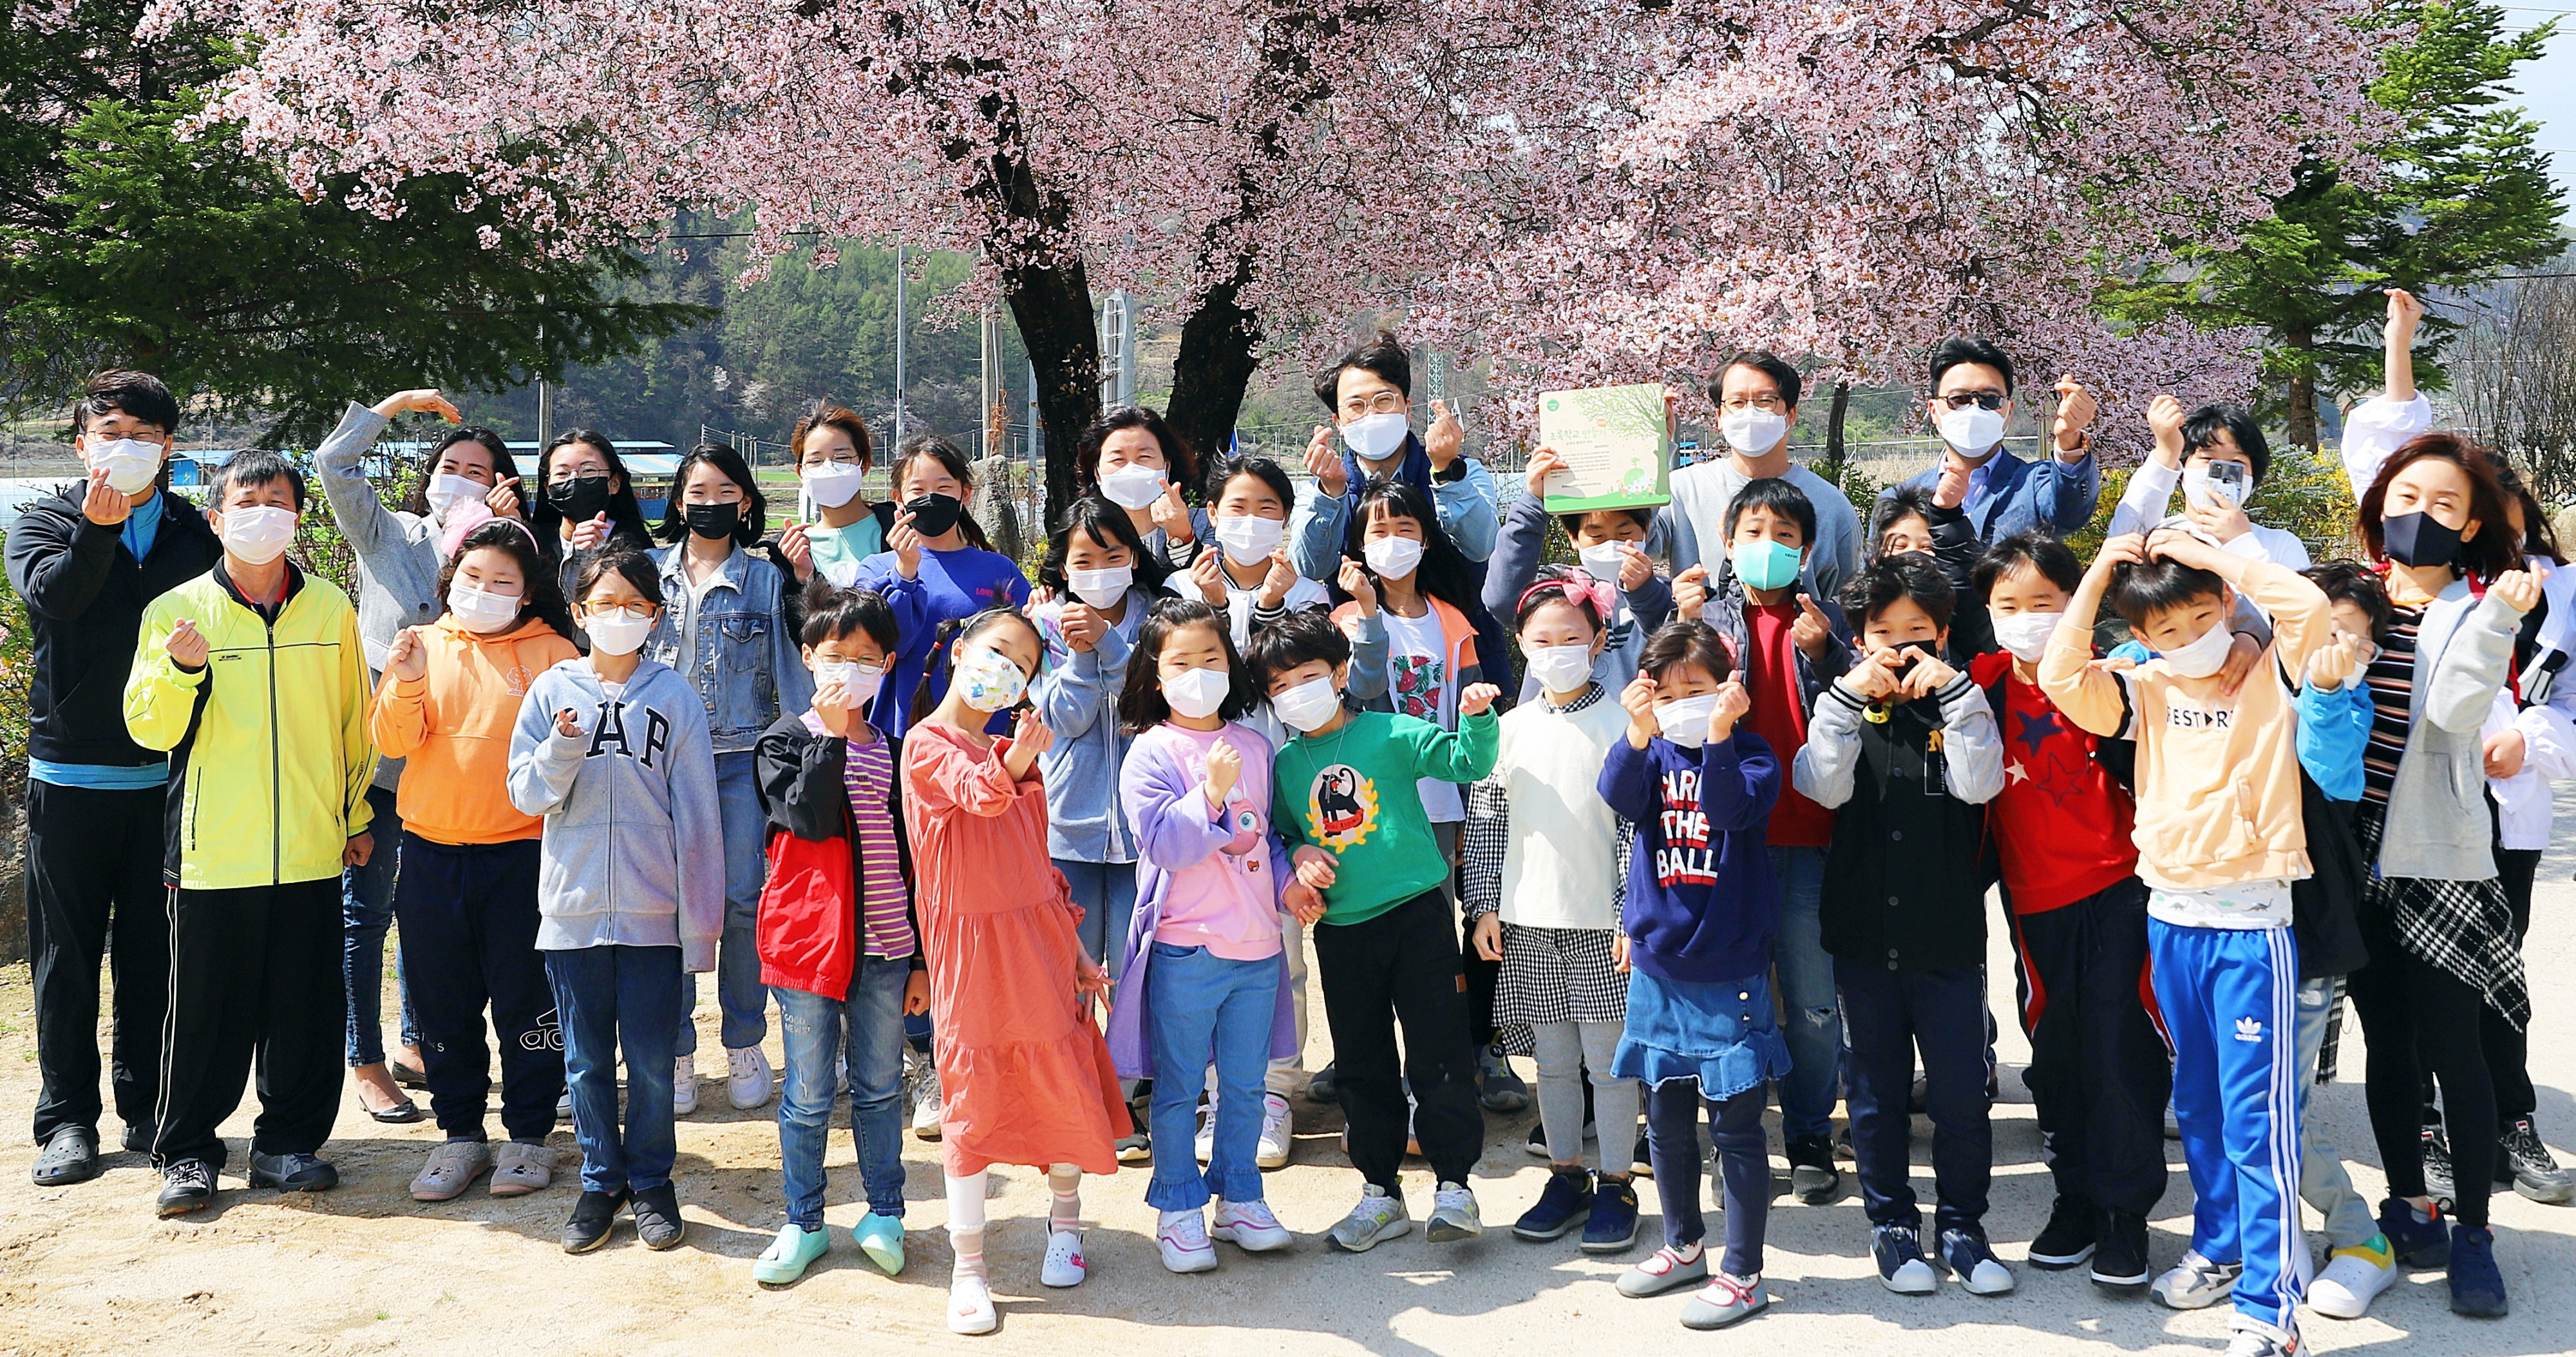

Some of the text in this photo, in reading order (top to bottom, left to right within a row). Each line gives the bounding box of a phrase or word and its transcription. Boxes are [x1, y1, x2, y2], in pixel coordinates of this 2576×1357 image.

[1549, 426, 1606, 441] 초록학교 만들기
[1660, 810, 1710, 842] THE
[1656, 847, 1718, 880] BALL
[784, 1013, 806, 1025] GOOD
[2235, 1033, 2262, 1043] adidas
